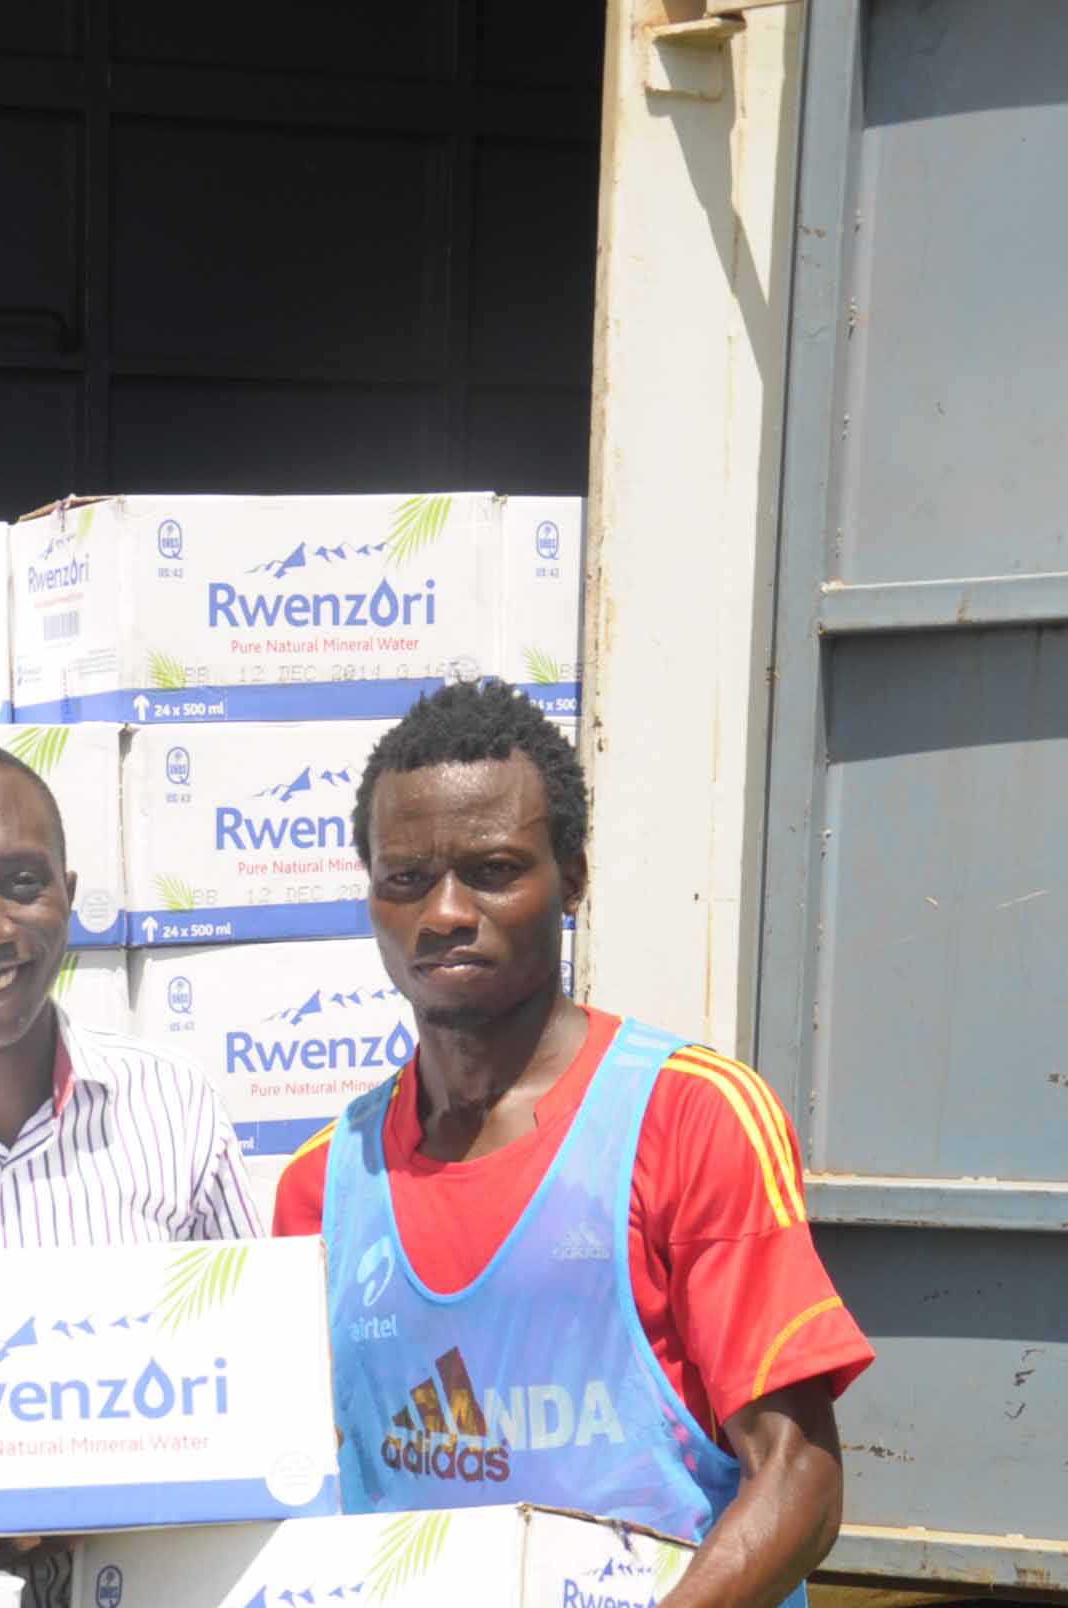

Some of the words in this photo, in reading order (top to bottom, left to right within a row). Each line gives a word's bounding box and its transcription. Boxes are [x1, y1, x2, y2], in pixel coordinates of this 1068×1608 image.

[208, 577, 435, 627] Rwenzori
[231, 639, 261, 654] Pure
[266, 637, 318, 653] Natural
[323, 636, 373, 652] Mineral
[379, 635, 420, 651] Water
[153, 703, 169, 717] 24
[183, 702, 207, 717] 500
[209, 701, 225, 715] ml
[216, 807, 356, 850] Rwen
[238, 862, 268, 876] Pure
[273, 859, 323, 875] Natural
[162, 926, 179, 938] 24
[191, 923, 214, 937] 500
[216, 922, 232, 936] ml
[251, 1083, 281, 1098] Pure
[285, 1080, 337, 1096] Natural
[349, 1314, 398, 1341] airtel
[71, 1433, 145, 1454] Mineral
[150, 1431, 210, 1451] Water
[382, 1430, 510, 1482] adidas
